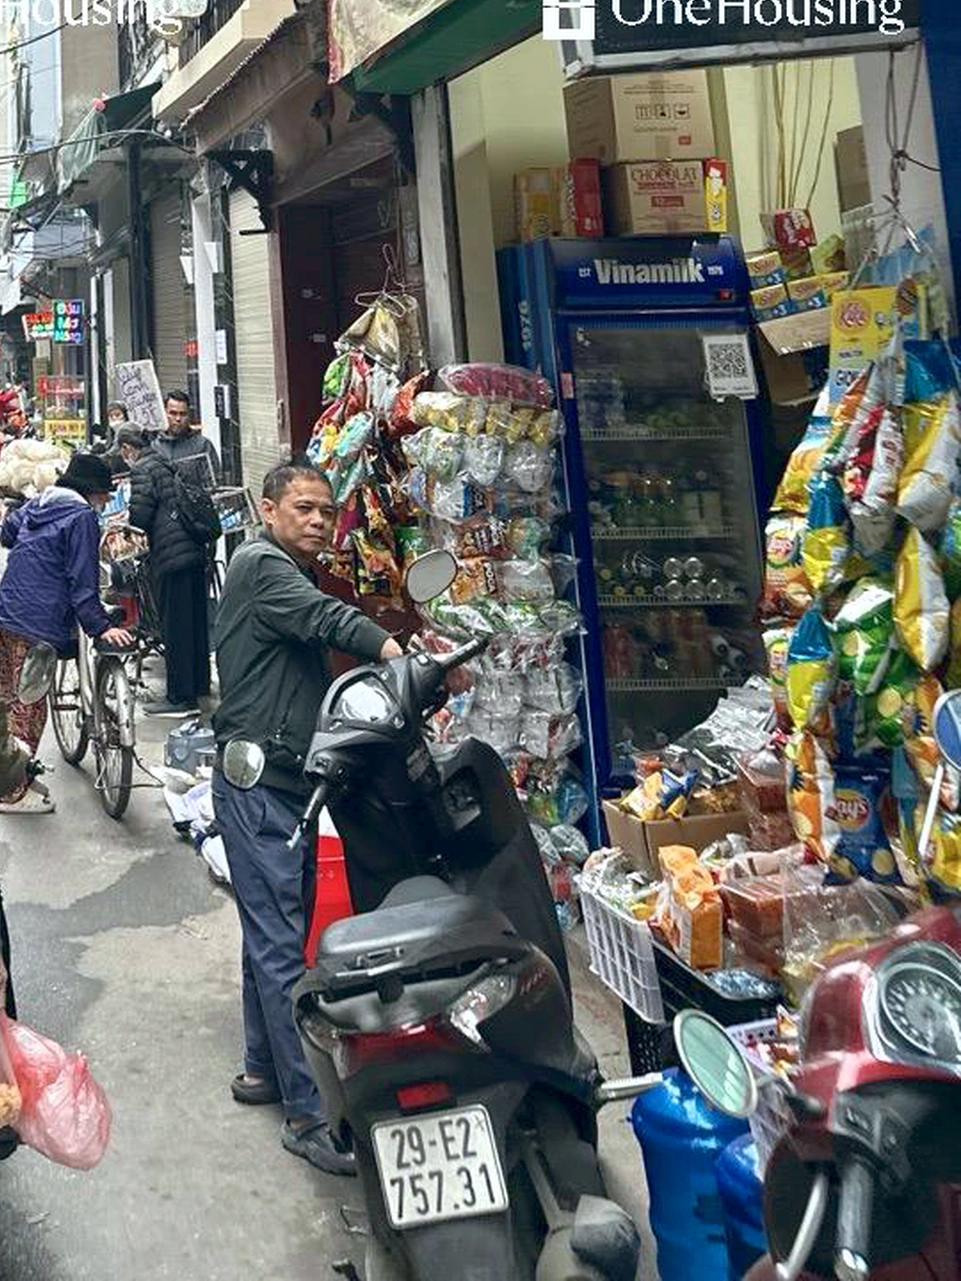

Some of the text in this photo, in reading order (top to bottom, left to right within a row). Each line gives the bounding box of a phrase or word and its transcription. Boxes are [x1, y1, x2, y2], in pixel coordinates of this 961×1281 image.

[594, 257, 705, 285] Vinamilk
[391, 1117, 478, 1170] 29-E2
[390, 1163, 496, 1220] 757.31
